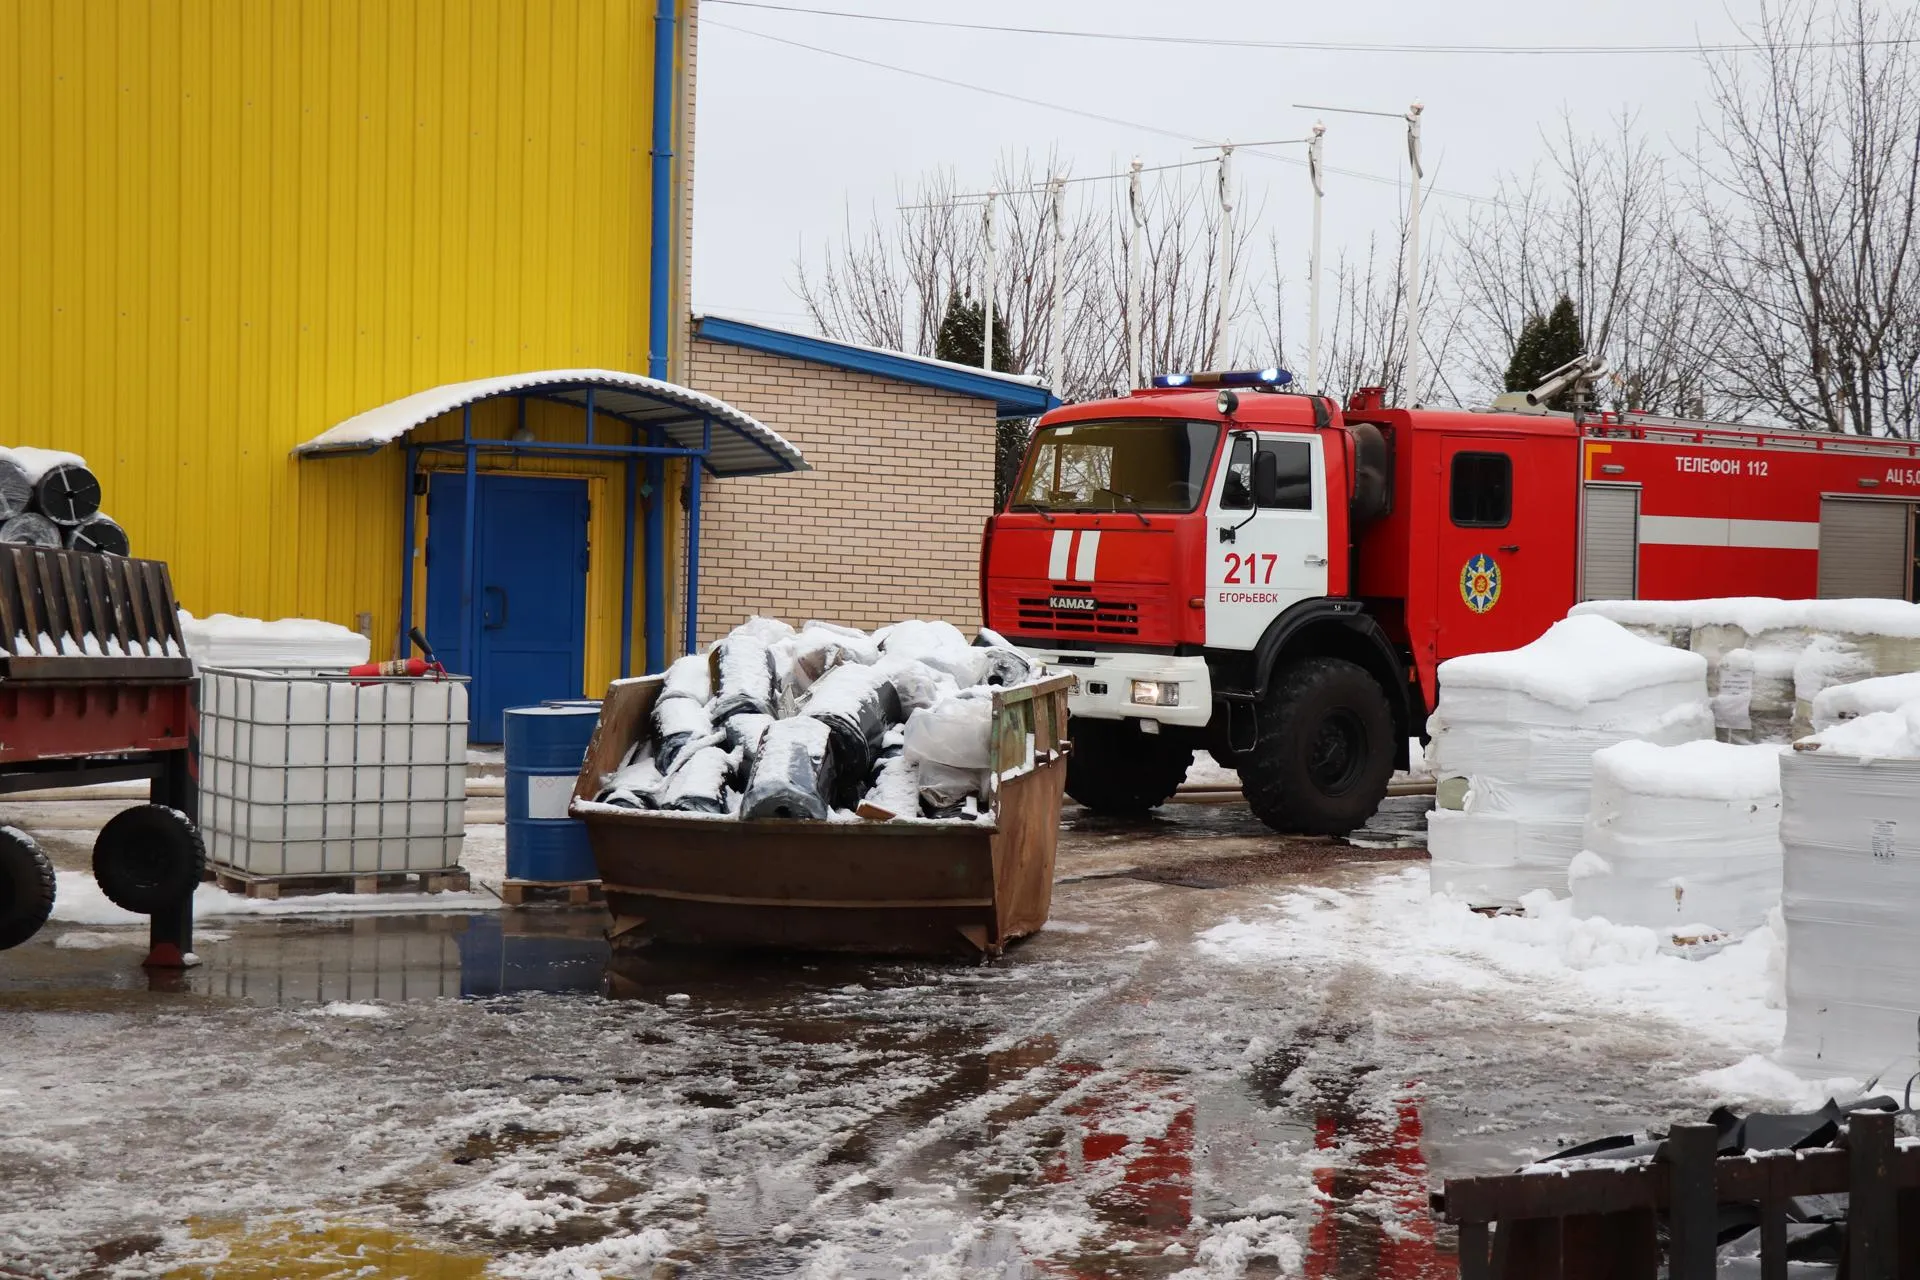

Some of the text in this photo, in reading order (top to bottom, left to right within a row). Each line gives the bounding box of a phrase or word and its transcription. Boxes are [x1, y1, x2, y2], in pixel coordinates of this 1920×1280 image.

[1675, 456, 1768, 476] ТЕЛЕФОН 112
[1885, 468, 1904, 486] АЦ
[1223, 552, 1278, 585] 217
[1049, 597, 1095, 610] KAMAZ
[1219, 592, 1279, 603] ЕГОРЬЕВСК
